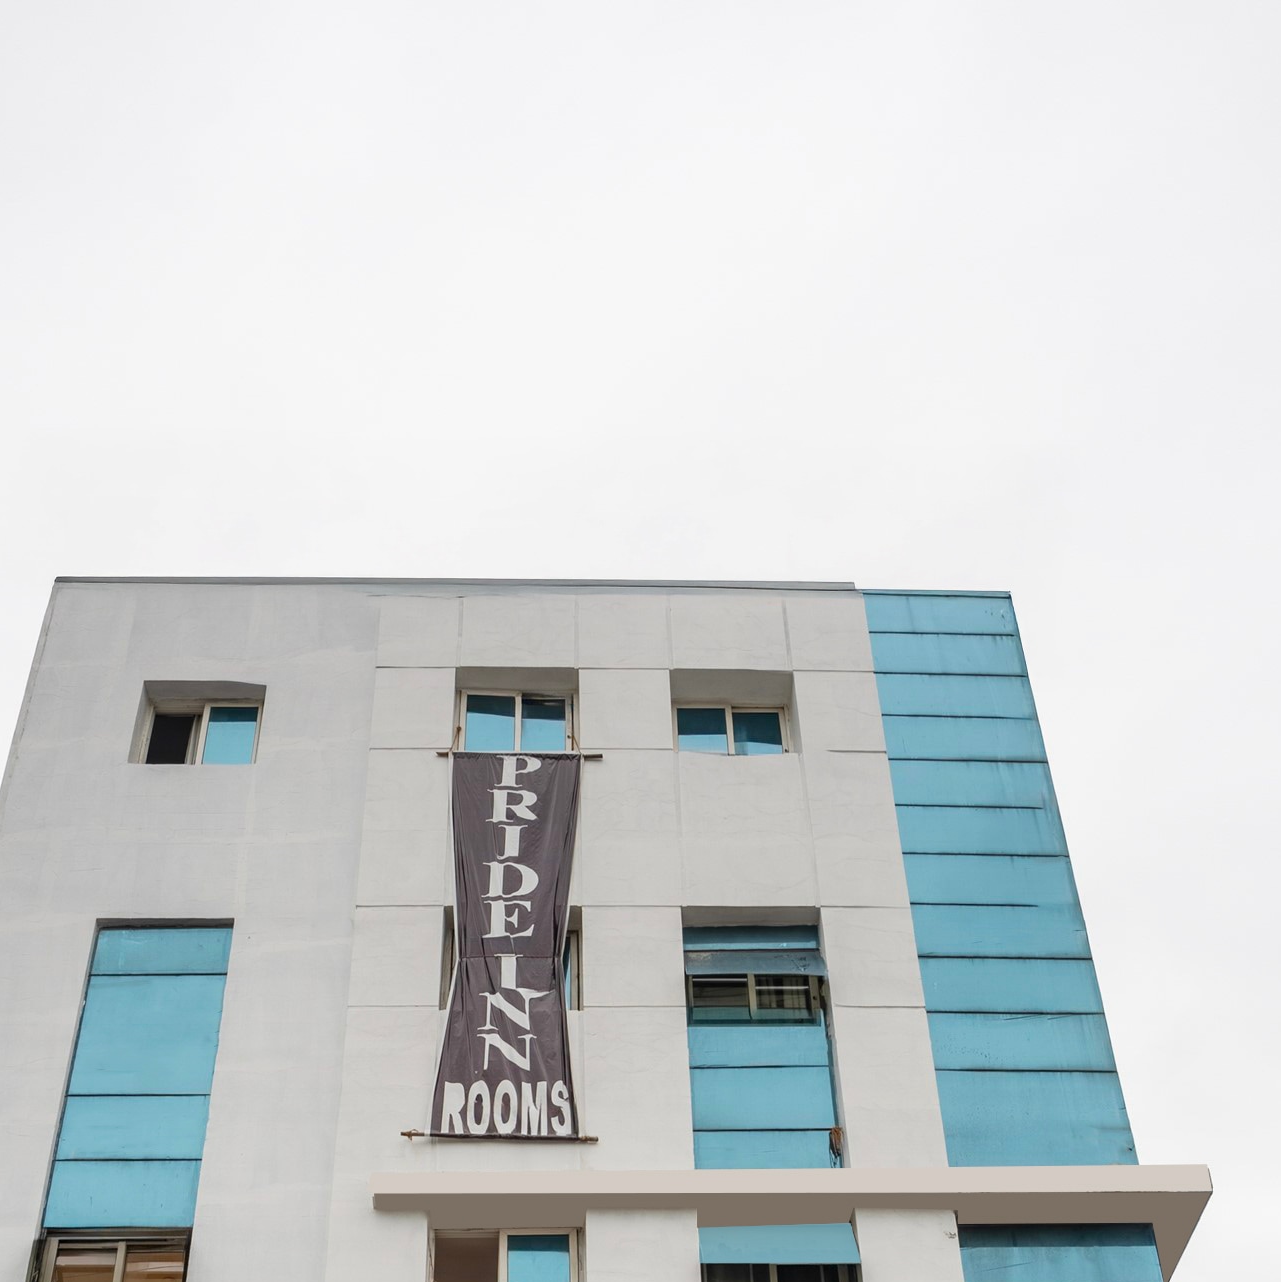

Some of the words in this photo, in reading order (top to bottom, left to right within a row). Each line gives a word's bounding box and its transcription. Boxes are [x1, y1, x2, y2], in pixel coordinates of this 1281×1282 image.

[481, 754, 542, 939] PRIDE
[477, 954, 555, 1071] INN
[440, 1079, 572, 1135] ROOMS
